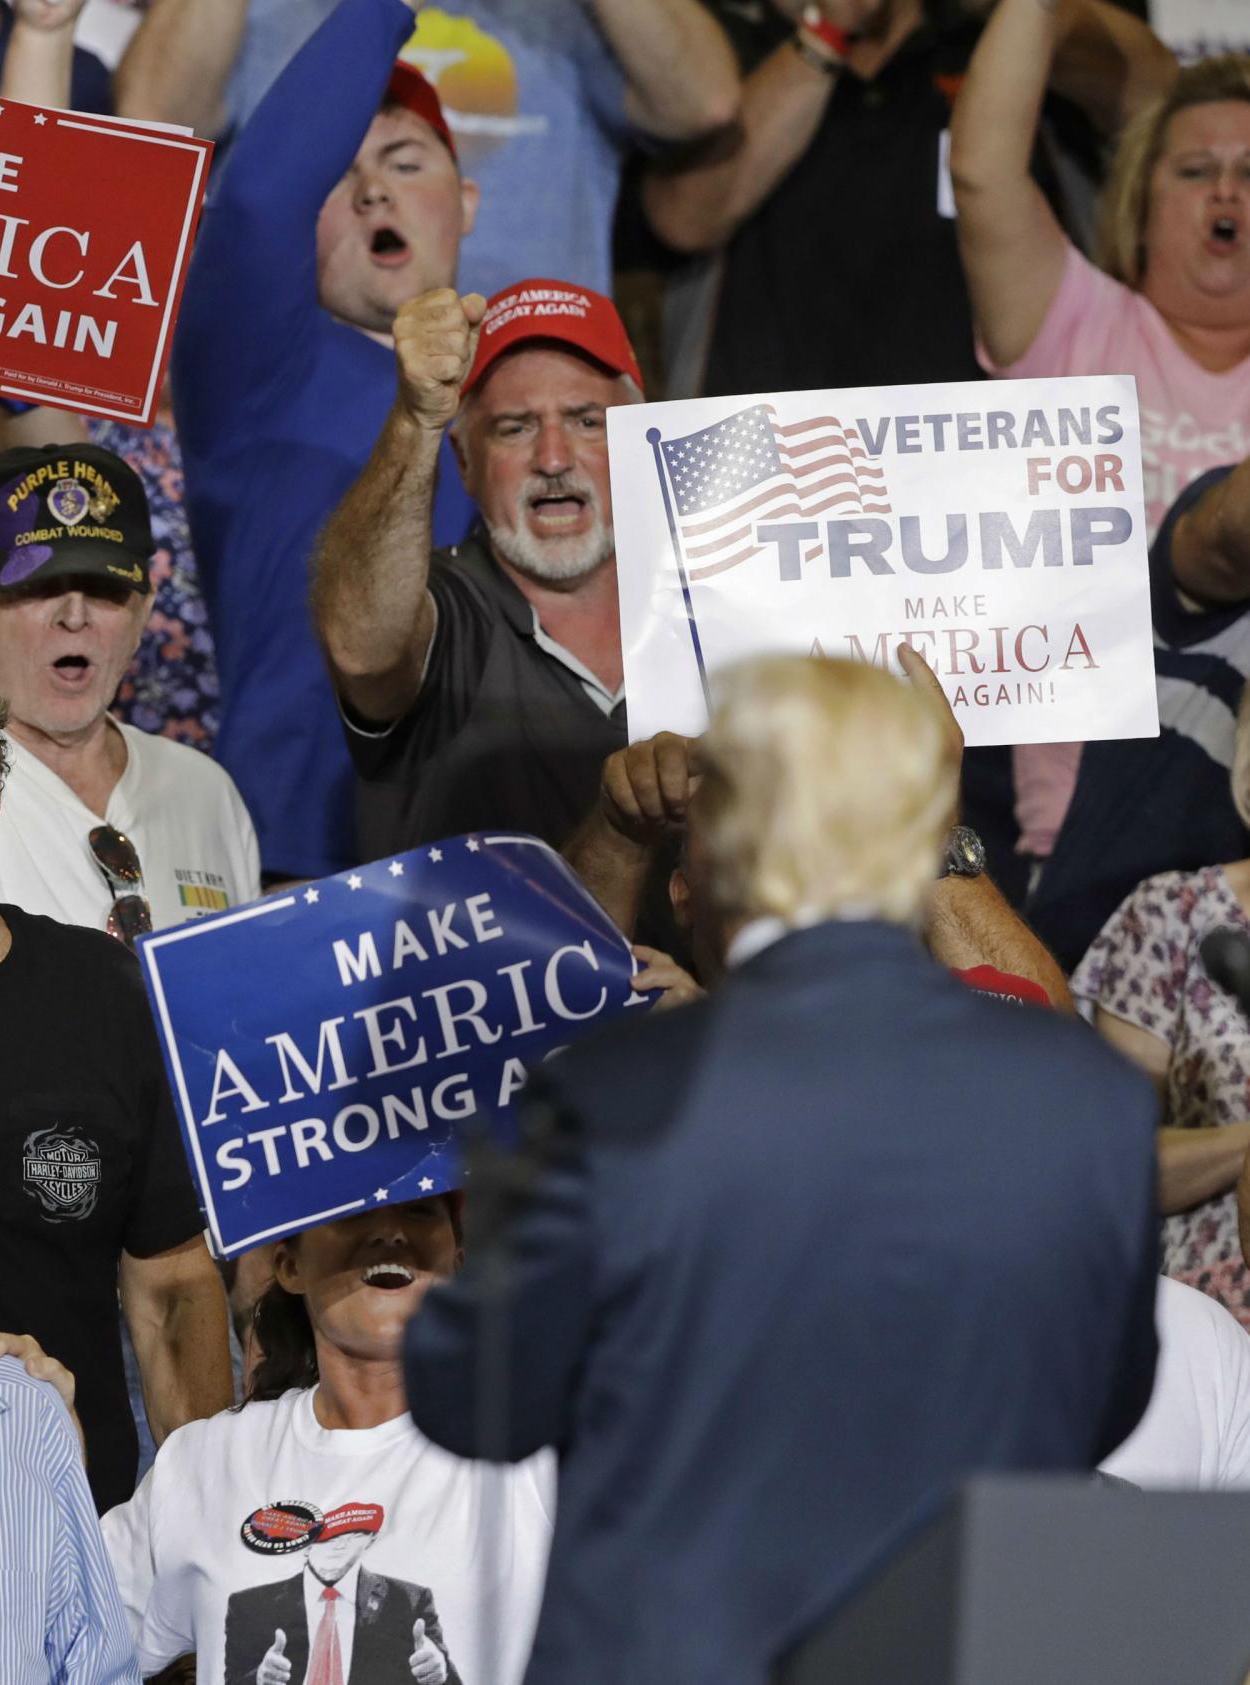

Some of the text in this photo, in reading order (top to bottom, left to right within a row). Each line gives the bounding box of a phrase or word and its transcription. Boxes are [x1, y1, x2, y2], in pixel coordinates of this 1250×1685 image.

[855, 405, 1123, 455] VETERANS
[7, 461, 69, 512] PURPLE
[1026, 454, 1125, 496] FOR
[15, 526, 123, 546] COMBAT WOUNDED
[756, 507, 1133, 580] TRUMP
[904, 594, 988, 620] MAKE
[953, 682, 1056, 707] AGAIN!
[332, 892, 504, 987] MAKE
[215, 1072, 478, 1191] STRONG
[31, 1163, 96, 1179] HARLEY-DAVIDSON
[50, 1180, 84, 1200] CYCLES
